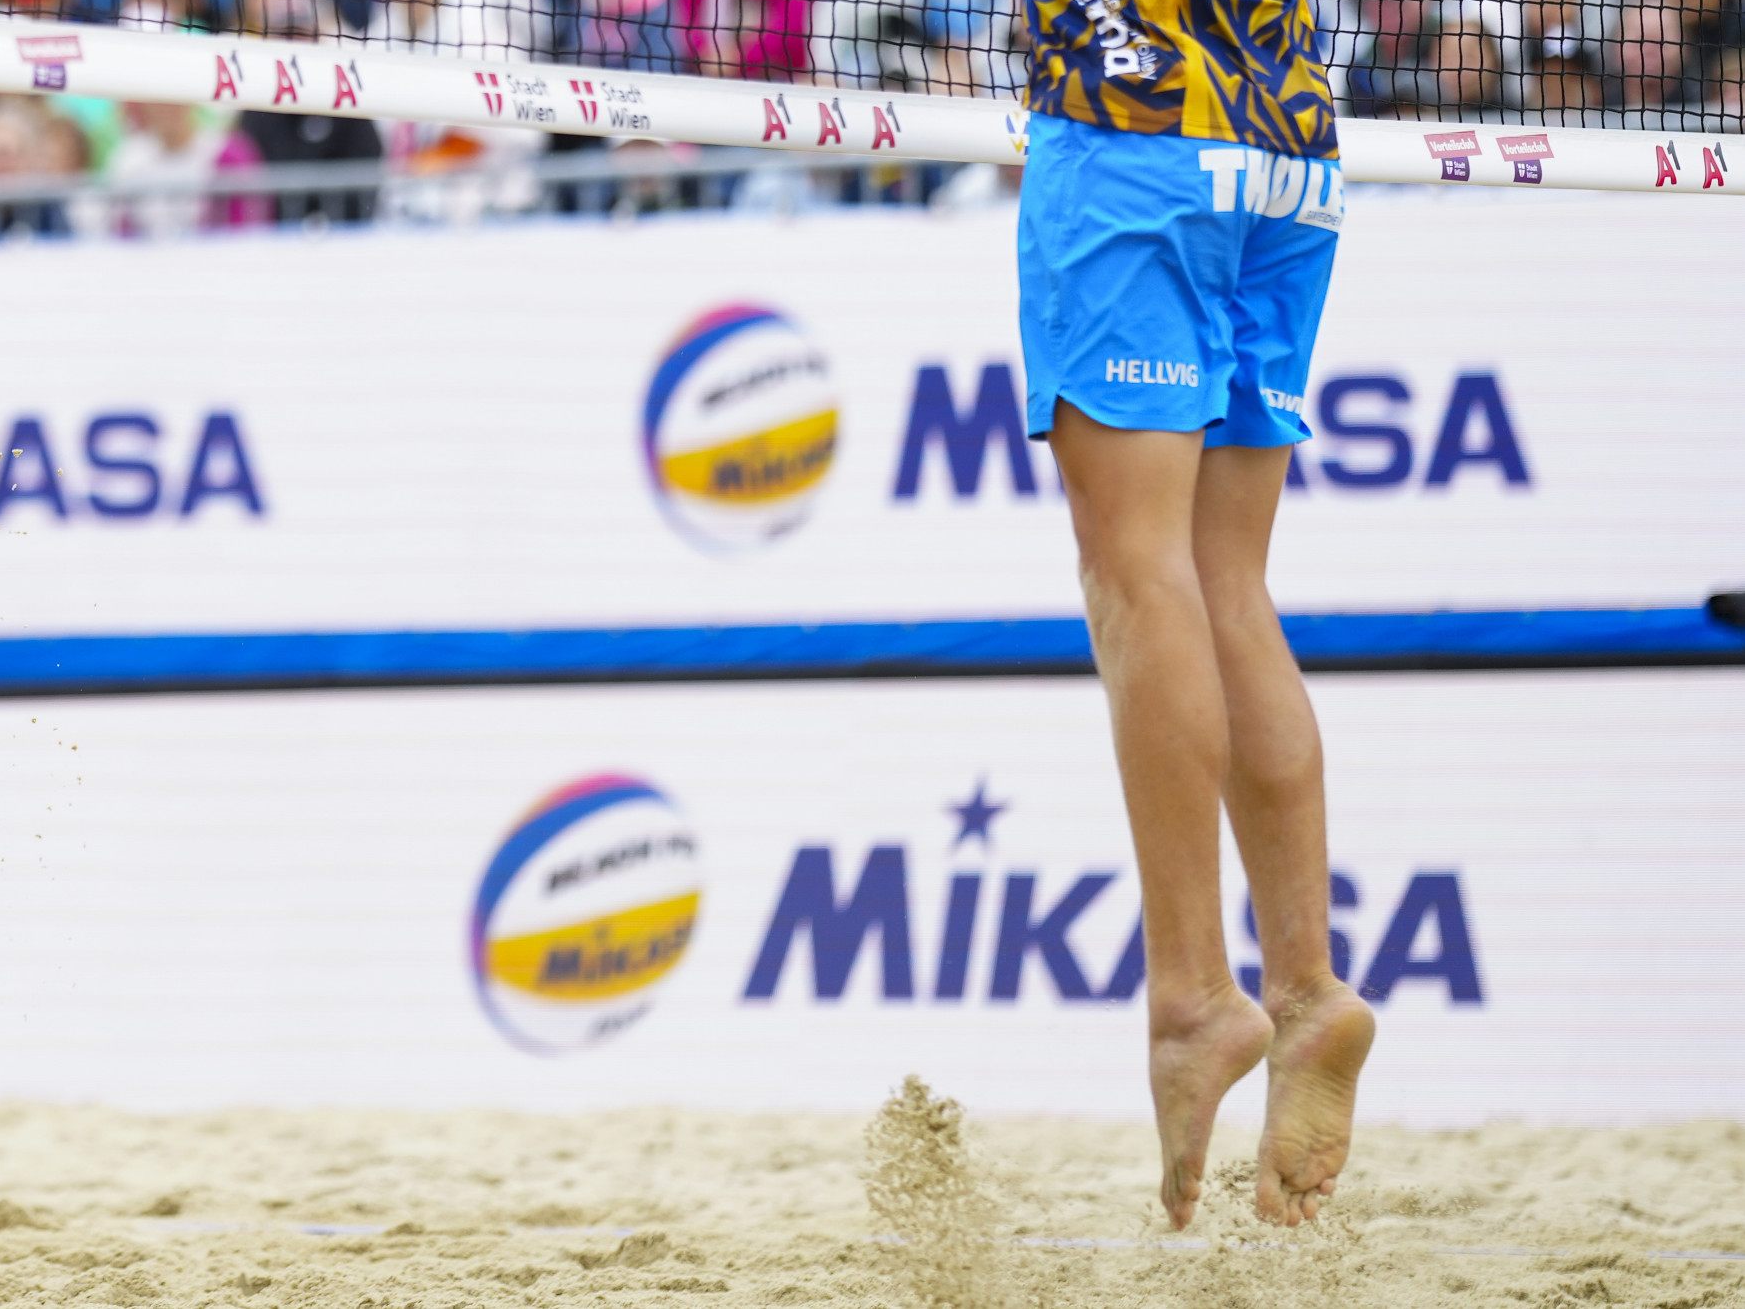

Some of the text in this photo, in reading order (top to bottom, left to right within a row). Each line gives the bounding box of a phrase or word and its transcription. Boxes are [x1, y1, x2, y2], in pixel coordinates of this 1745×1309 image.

[214, 50, 362, 110] A1 A1 A1
[507, 74, 547, 96] Stadt
[601, 81, 643, 104] Stadt
[513, 100, 556, 122] Wien
[607, 106, 651, 130] Wien
[762, 93, 901, 150] A1 A1 A1
[1429, 138, 1476, 152] Vorteilsclub
[1502, 141, 1548, 155] Vorteilsclub
[1655, 139, 1728, 190] A1 A1
[1105, 359, 1199, 388] HELLVIG
[890, 361, 1535, 503] MSA
